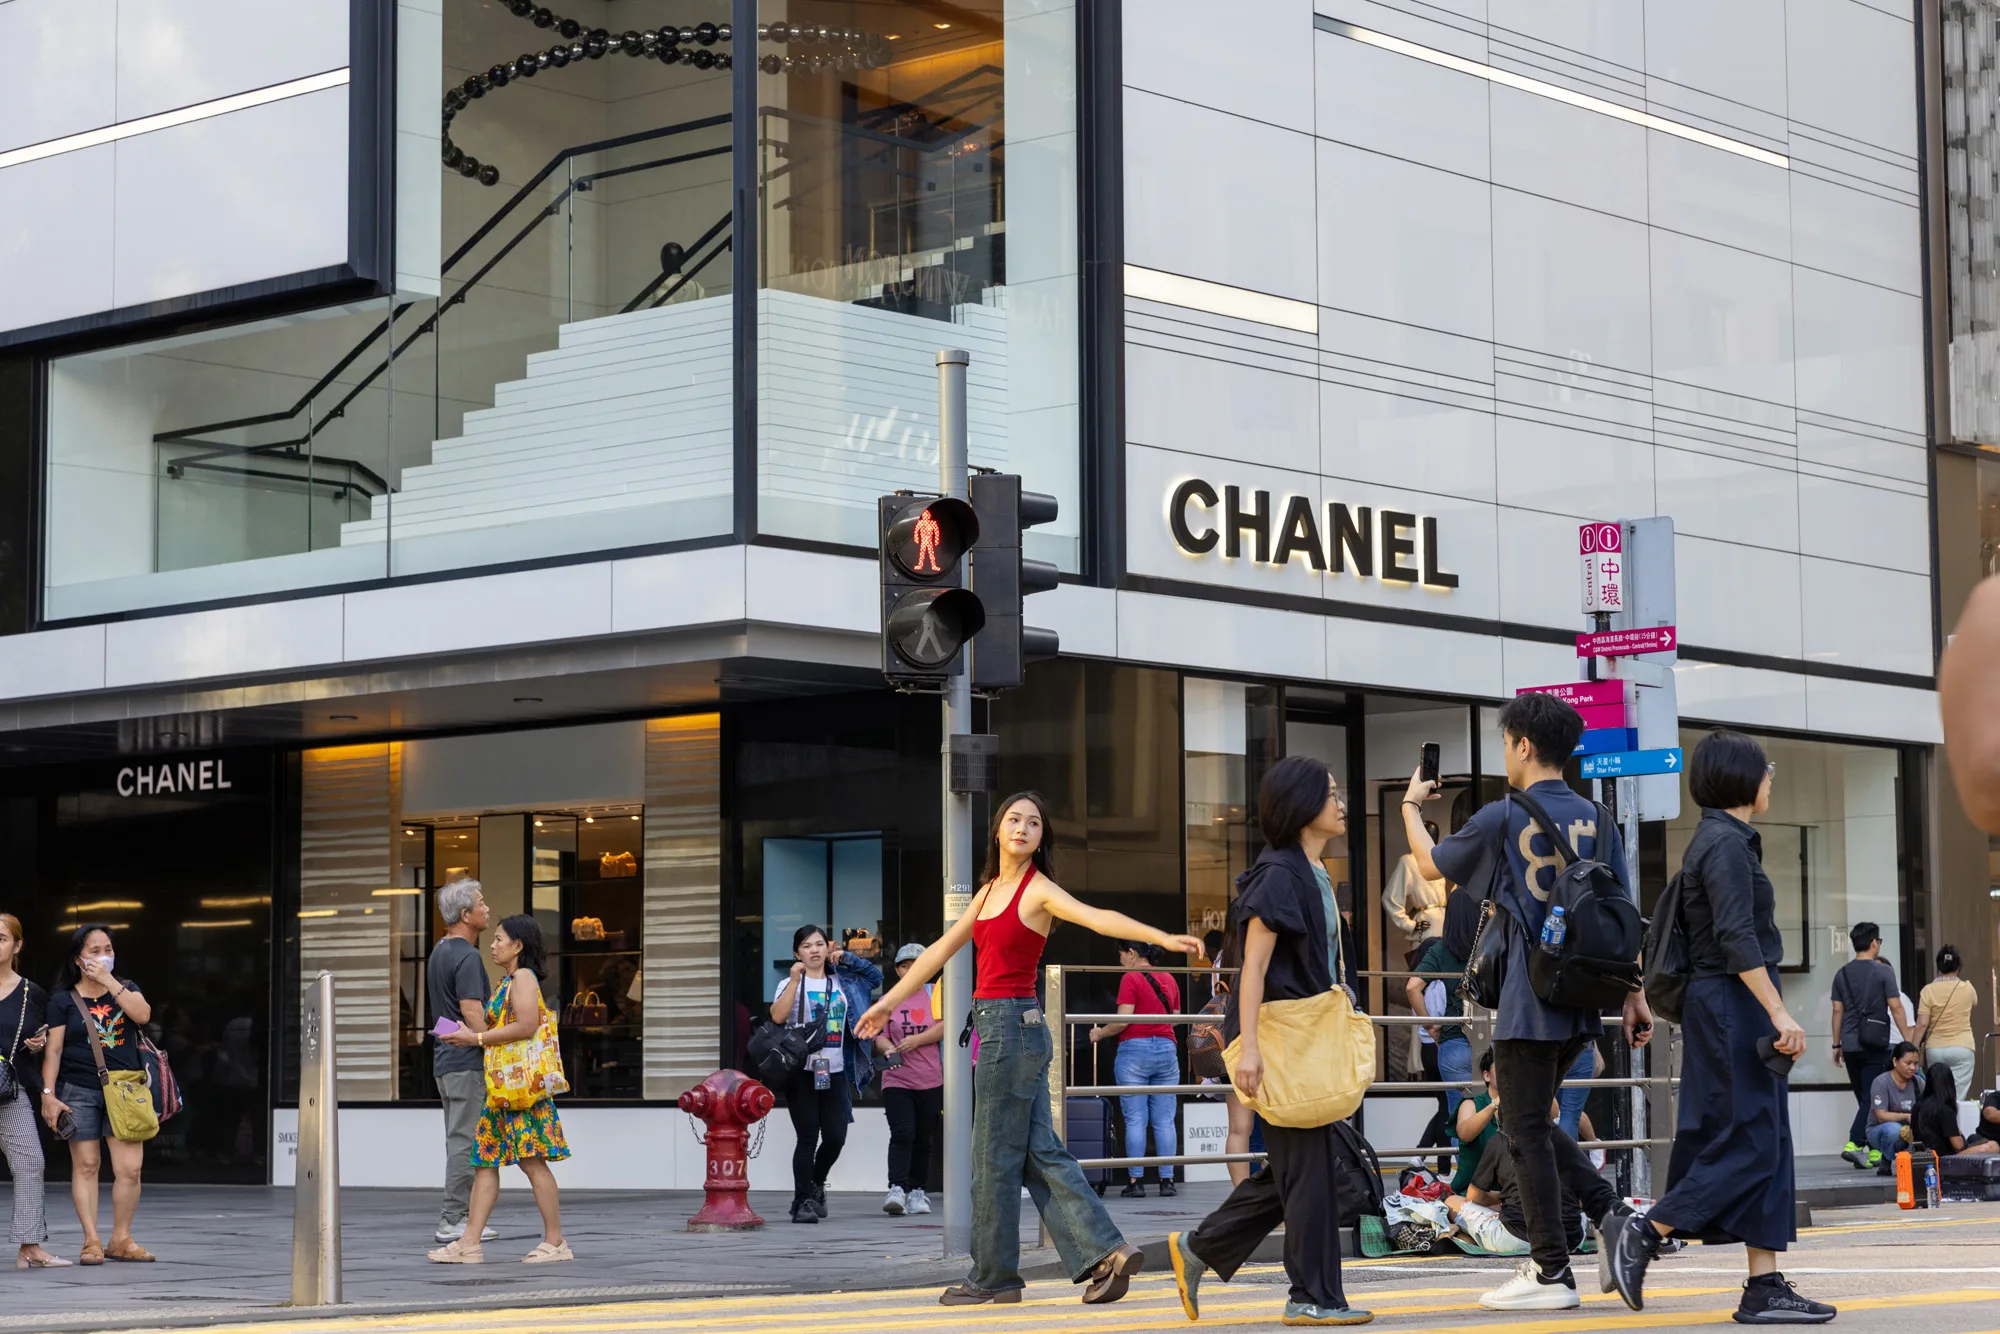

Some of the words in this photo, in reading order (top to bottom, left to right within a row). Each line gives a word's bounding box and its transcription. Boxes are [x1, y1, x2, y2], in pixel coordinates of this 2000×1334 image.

[1169, 478, 1459, 588] CHANEL
[1585, 558, 1593, 606] Central
[1601, 558, 1620, 605] 中環
[1579, 695, 1593, 703] Park
[1597, 756, 1621, 766] 天星小輪
[1608, 766, 1622, 774] Ferry
[117, 760, 232, 797] CHANEL
[950, 884, 972, 892] H291
[900, 1009, 911, 1025] I
[278, 1132, 297, 1143] SMOKE
[1189, 1126, 1210, 1139] SMOKE
[1210, 1126, 1228, 1138] VENT
[710, 1160, 745, 1177] 307
